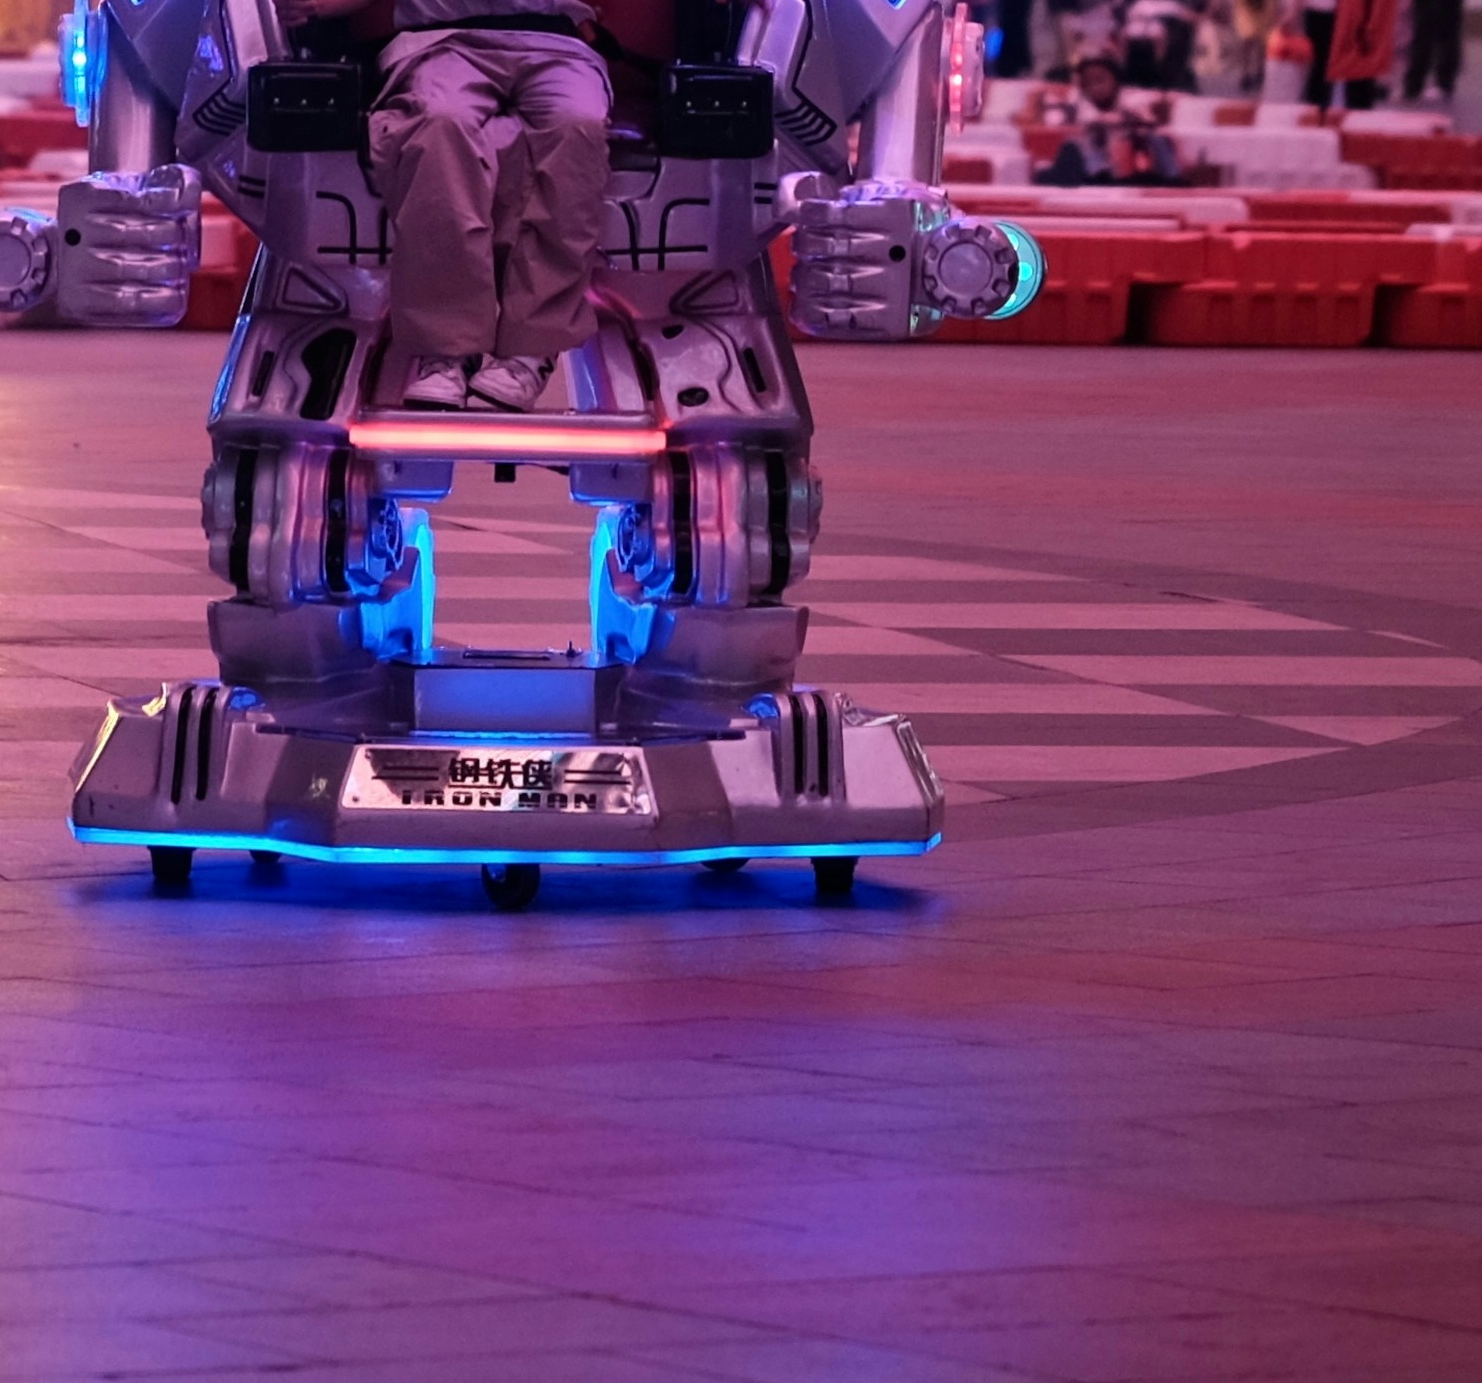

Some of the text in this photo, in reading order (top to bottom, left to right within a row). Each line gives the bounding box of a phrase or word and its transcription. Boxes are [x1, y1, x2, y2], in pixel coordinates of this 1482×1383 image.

[447, 757, 554, 790] 钢铁侠
[401, 789, 598, 810] IRON MAN
